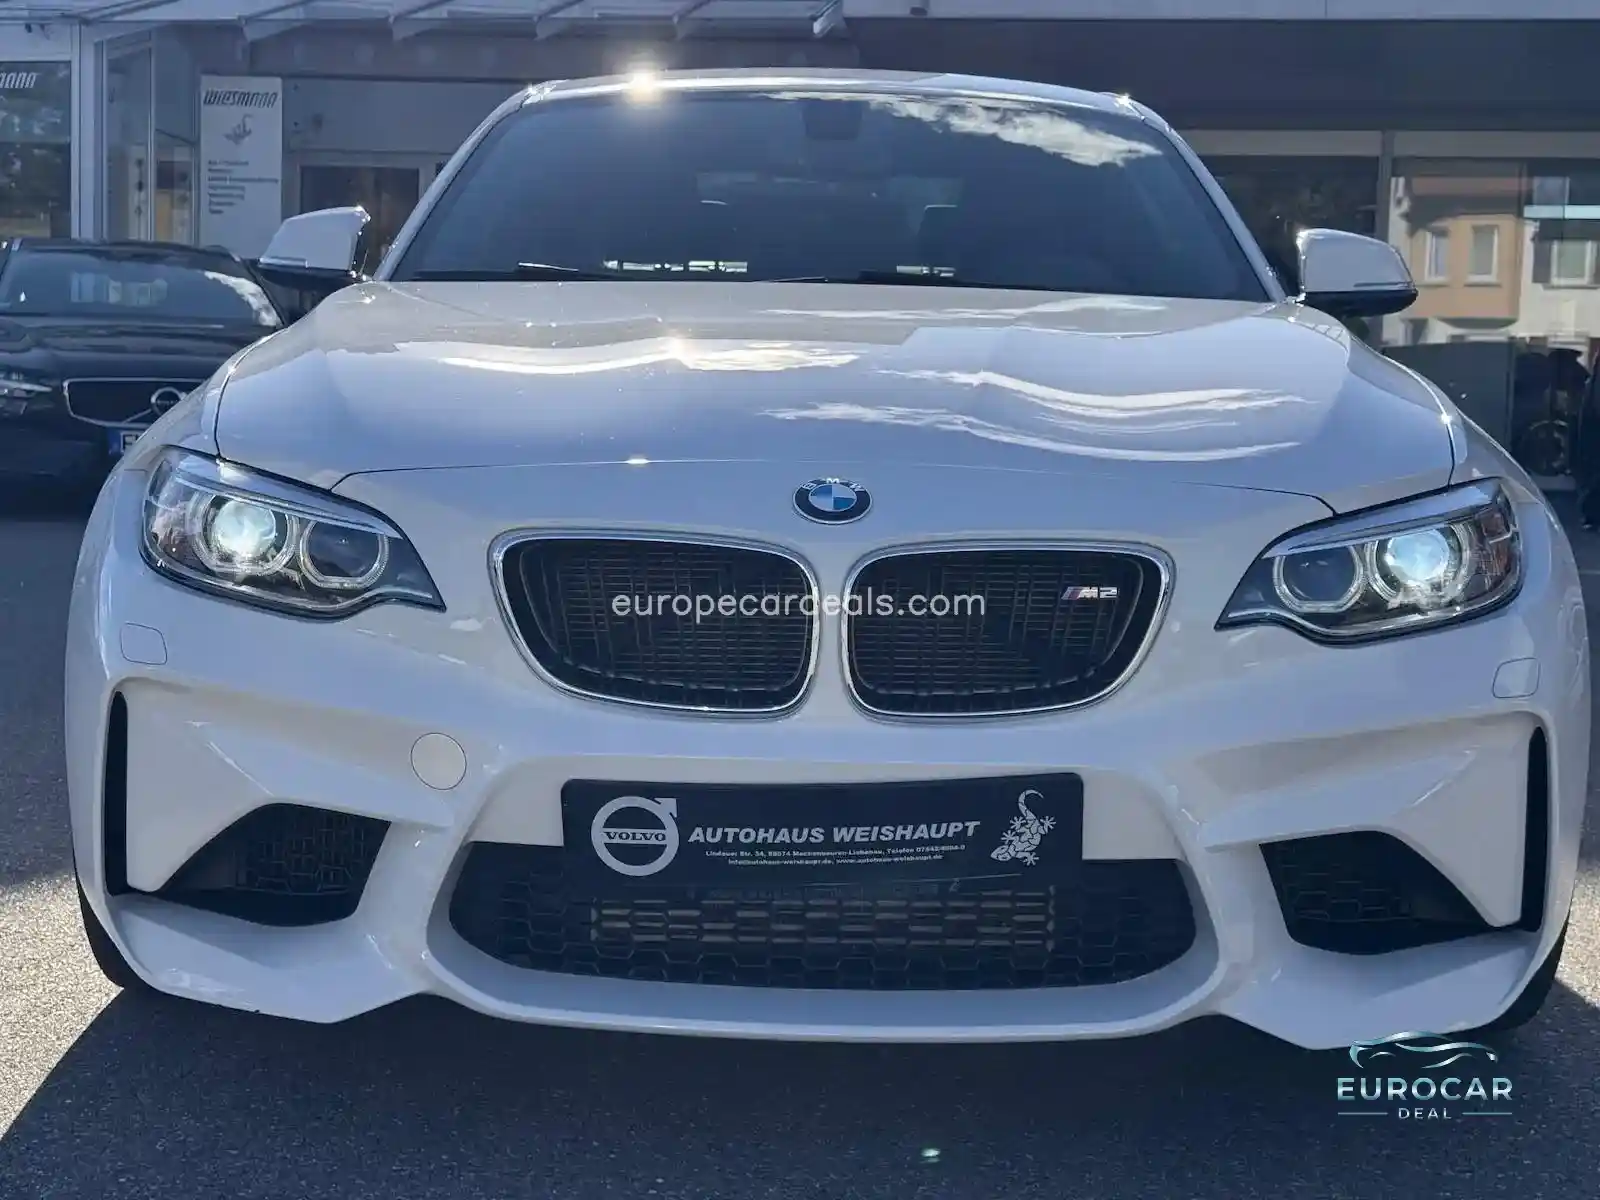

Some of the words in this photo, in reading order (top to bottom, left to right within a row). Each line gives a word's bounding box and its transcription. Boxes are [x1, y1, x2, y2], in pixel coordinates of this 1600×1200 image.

[801, 478, 866, 491] BMW
[1076, 586, 1118, 600] M2
[603, 831, 667, 842] VOLVO
[688, 827, 825, 843] AUTOHAUS
[833, 821, 981, 842] WEISHAUPT
